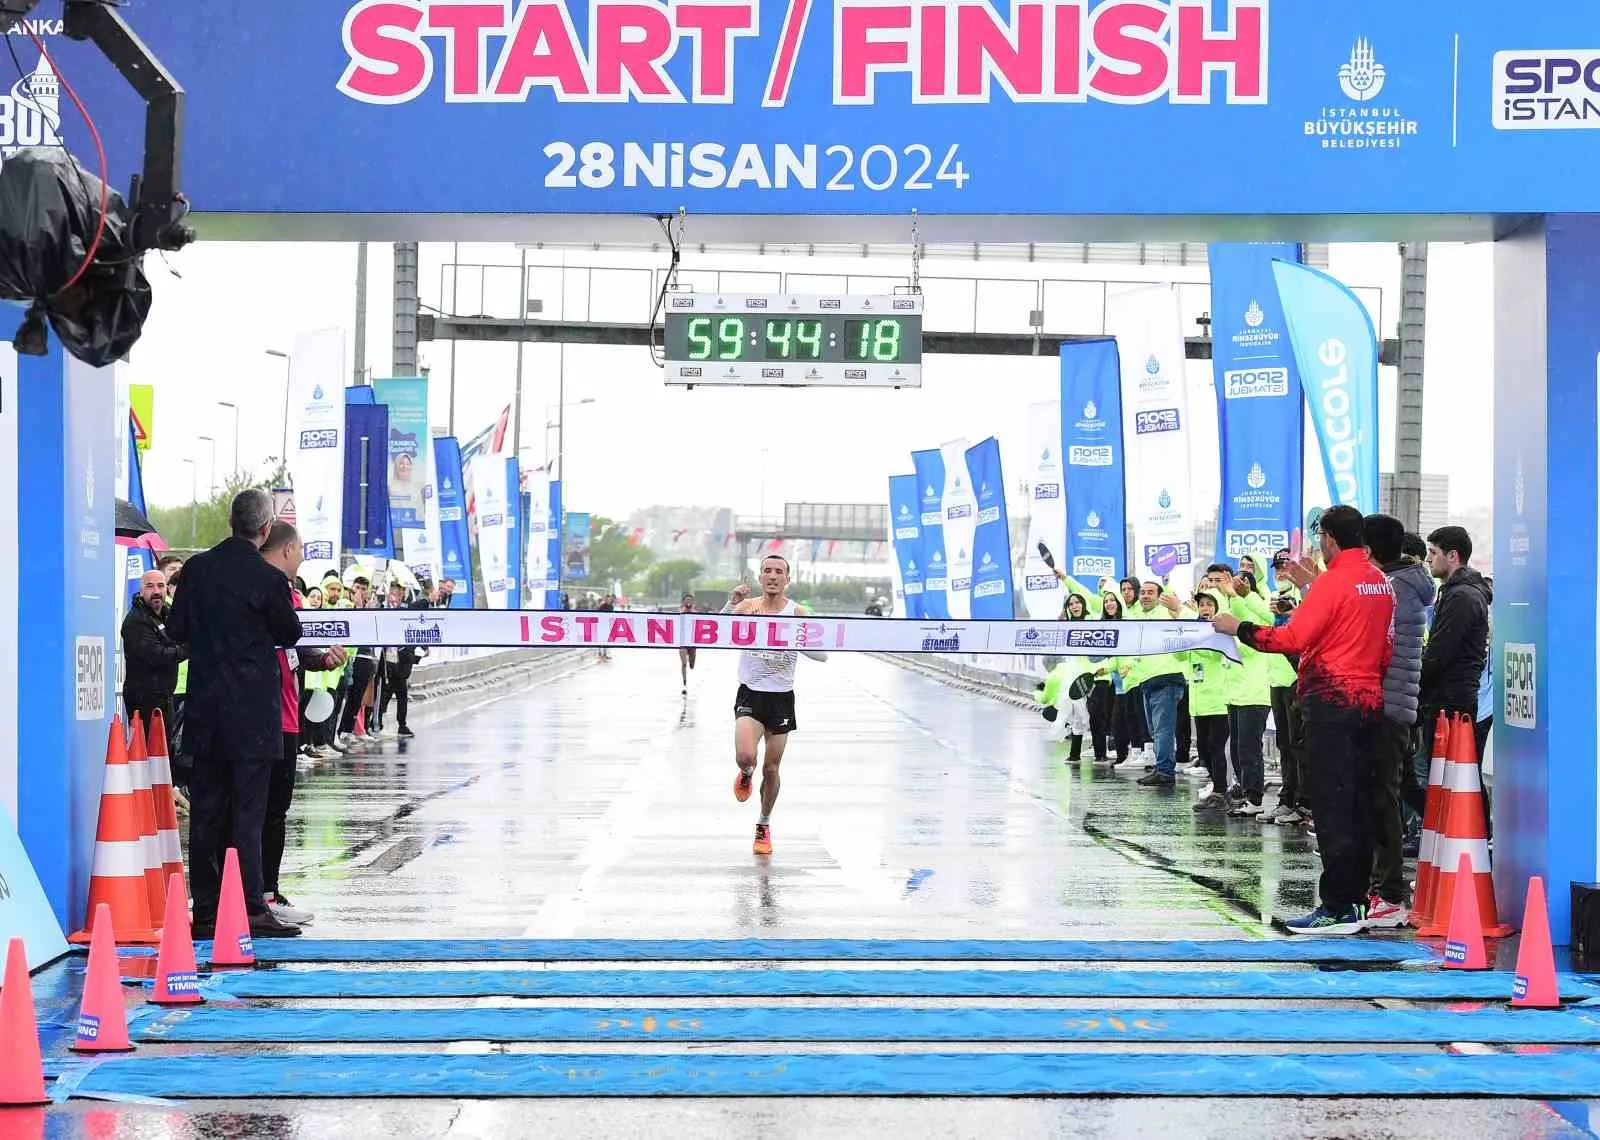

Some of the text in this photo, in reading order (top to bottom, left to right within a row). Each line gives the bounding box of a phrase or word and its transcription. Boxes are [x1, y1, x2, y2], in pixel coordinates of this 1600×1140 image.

[336, 0, 760, 104] START
[832, 0, 1269, 105] FINISH
[1304, 118, 1418, 137] BÜYÜKŞEHİR
[542, 142, 614, 189] 28
[825, 143, 970, 191] 2024
[302, 622, 345, 631] SPOR
[519, 615, 789, 647] ISTANBUL
[1069, 630, 1115, 640] SPOR
[77, 644, 103, 683] SPOR
[1506, 652, 1534, 690] SPOR
